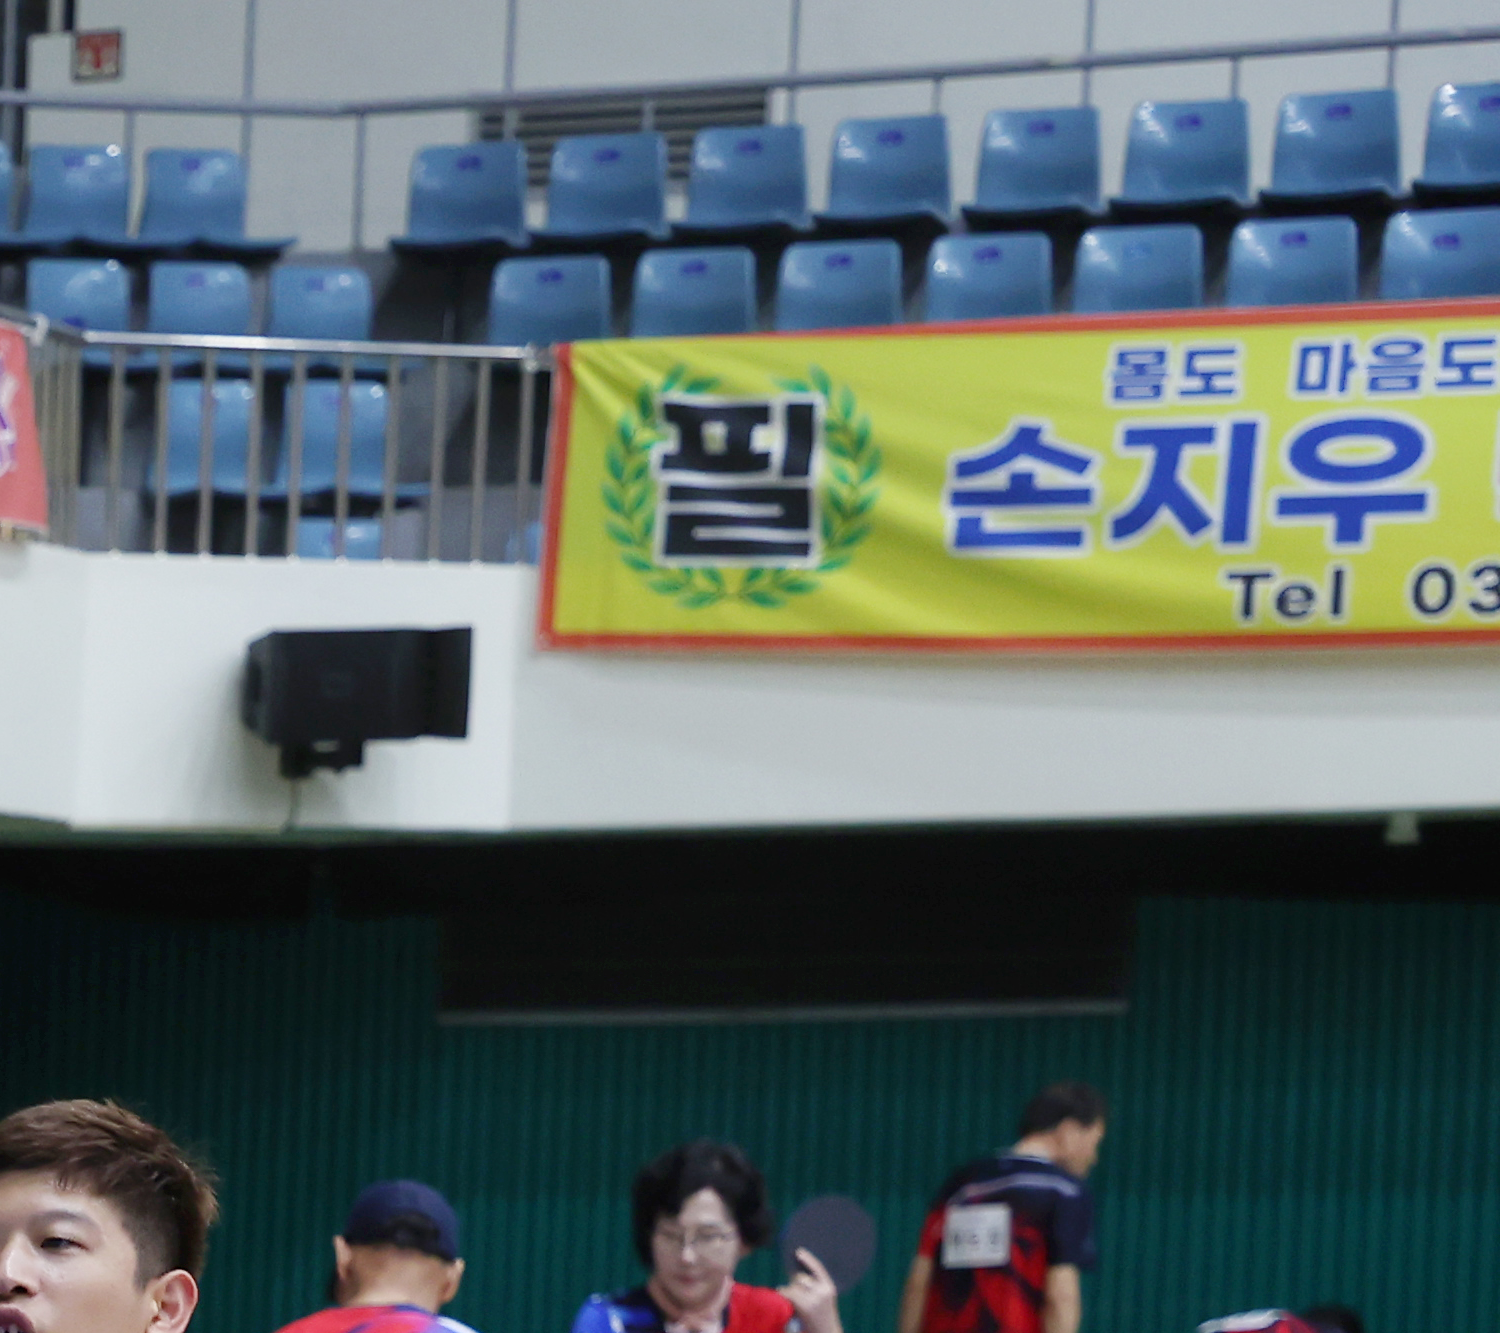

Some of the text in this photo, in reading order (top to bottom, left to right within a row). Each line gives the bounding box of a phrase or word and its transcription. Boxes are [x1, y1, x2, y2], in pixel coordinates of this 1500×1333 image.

[1112, 335, 1497, 400] 몸도 마음도
[661, 402, 1428, 557] 필 손지우
[1226, 567, 1346, 621] Tel
